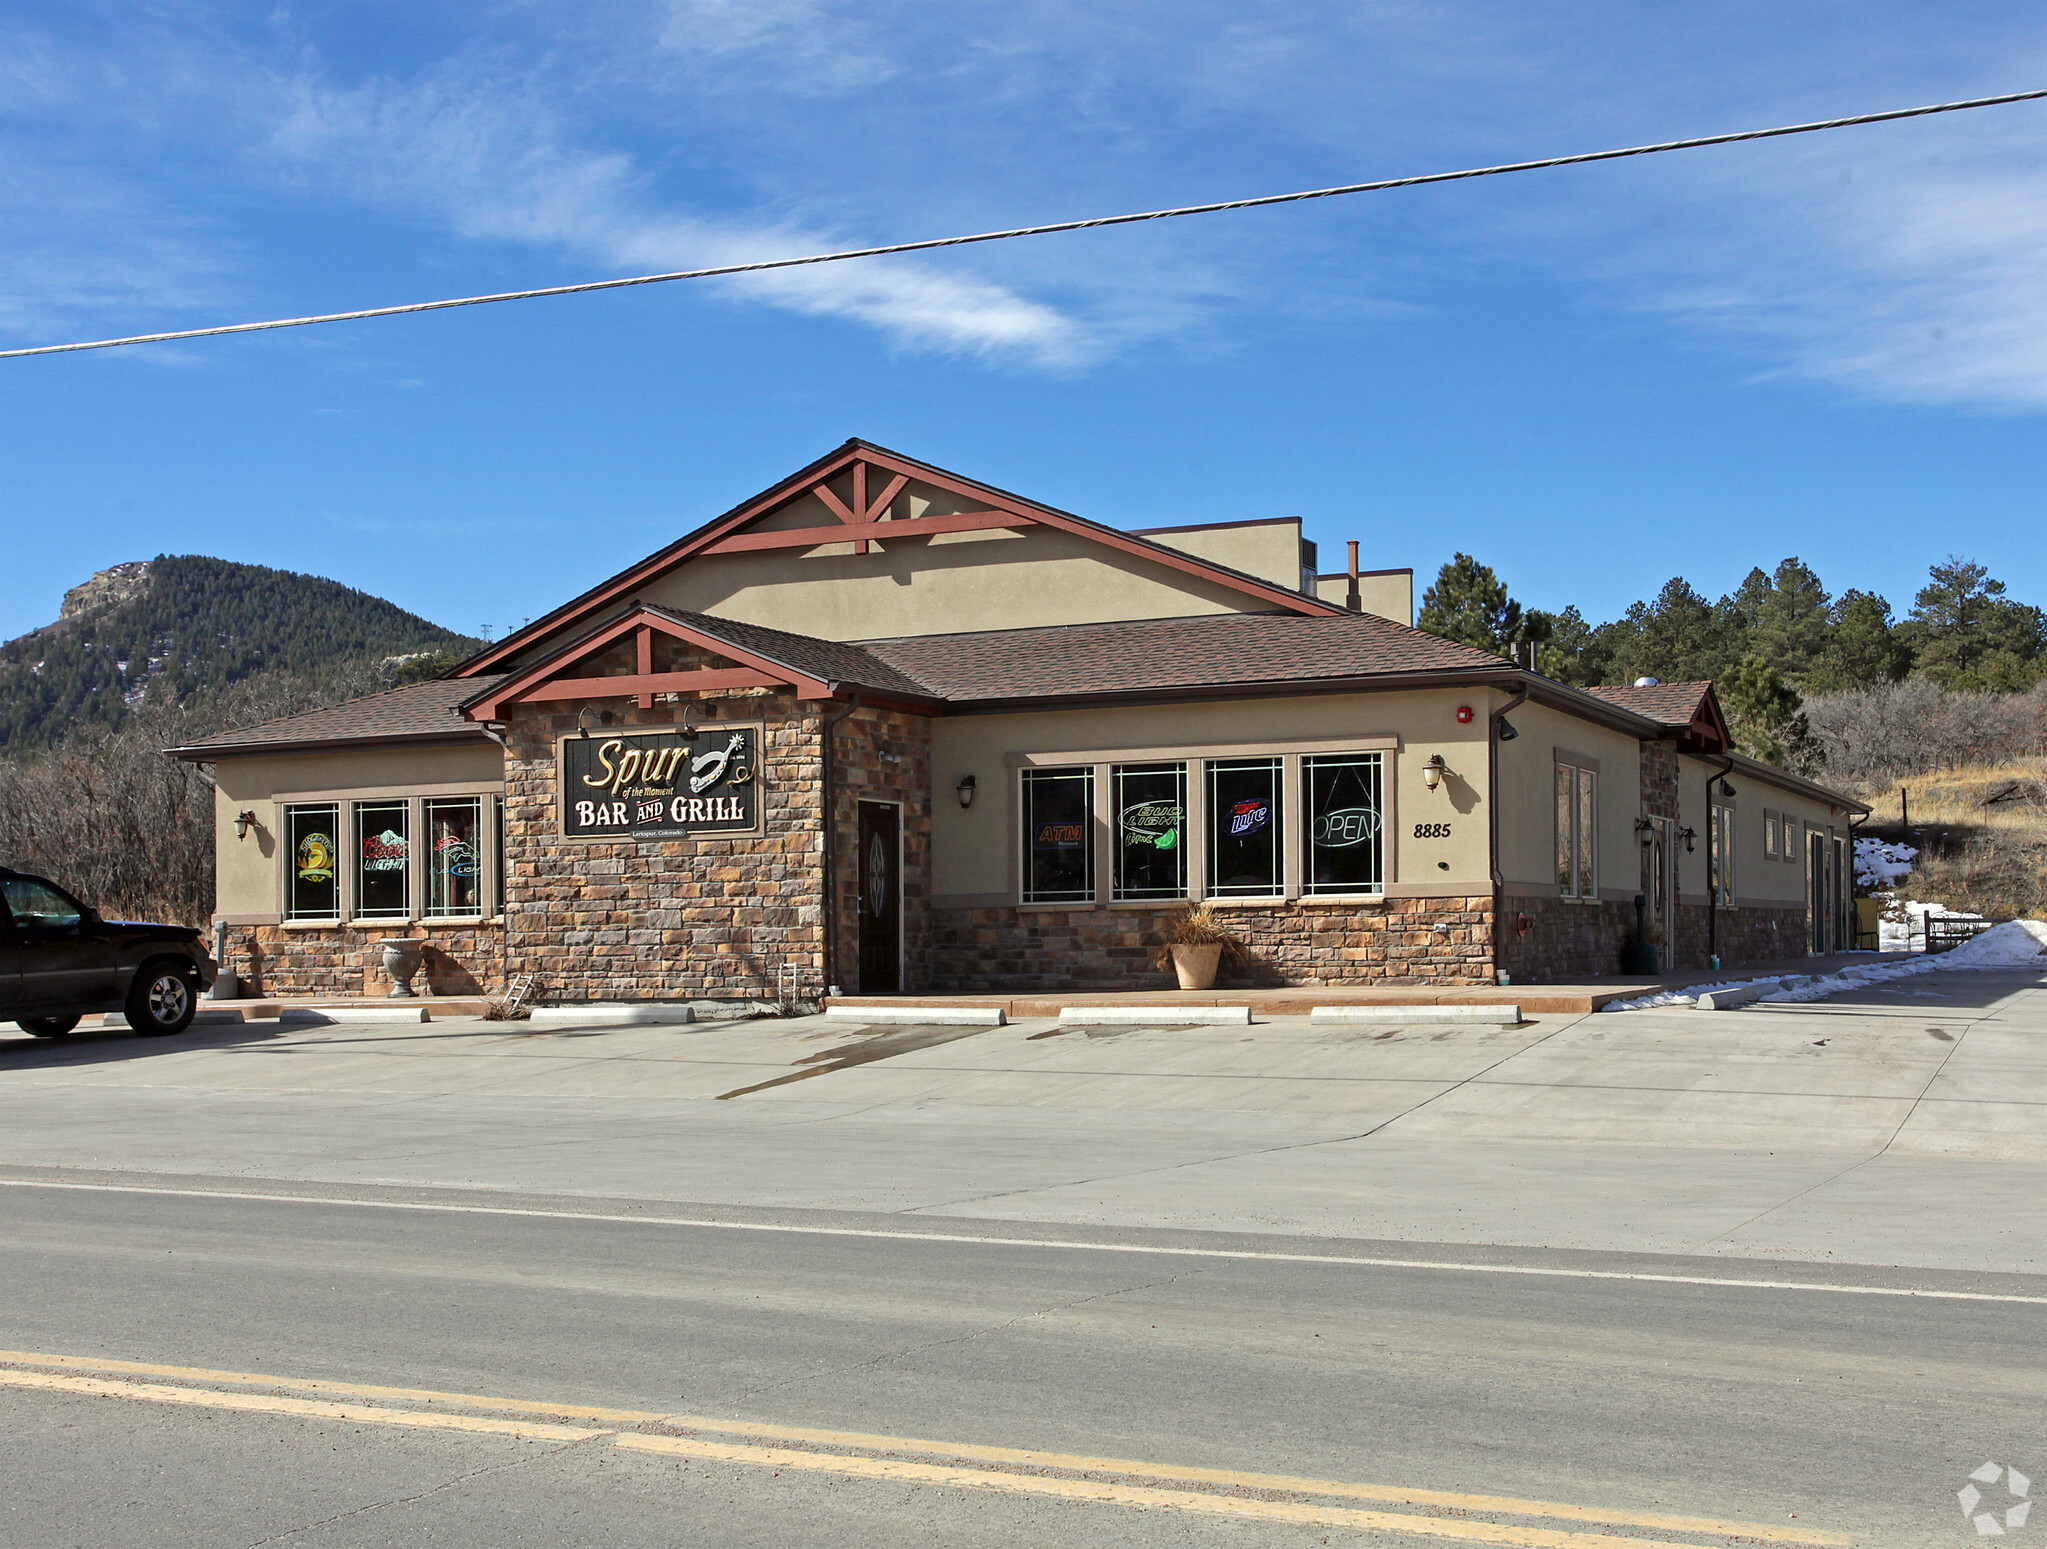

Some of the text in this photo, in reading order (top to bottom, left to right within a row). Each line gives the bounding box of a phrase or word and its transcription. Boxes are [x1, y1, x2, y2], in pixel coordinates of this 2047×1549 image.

[583, 740, 692, 797] Spur
[622, 787, 631, 799] of
[631, 786, 643, 797] the
[575, 796, 745, 827] BAR AND GRILL
[1136, 806, 1184, 817] BUD
[1126, 815, 1186, 826] LIGHT
[1312, 815, 1376, 840] OPEN
[1039, 825, 1083, 841] ATM
[1125, 831, 1154, 847] Lime
[1413, 823, 1452, 839] 8885
